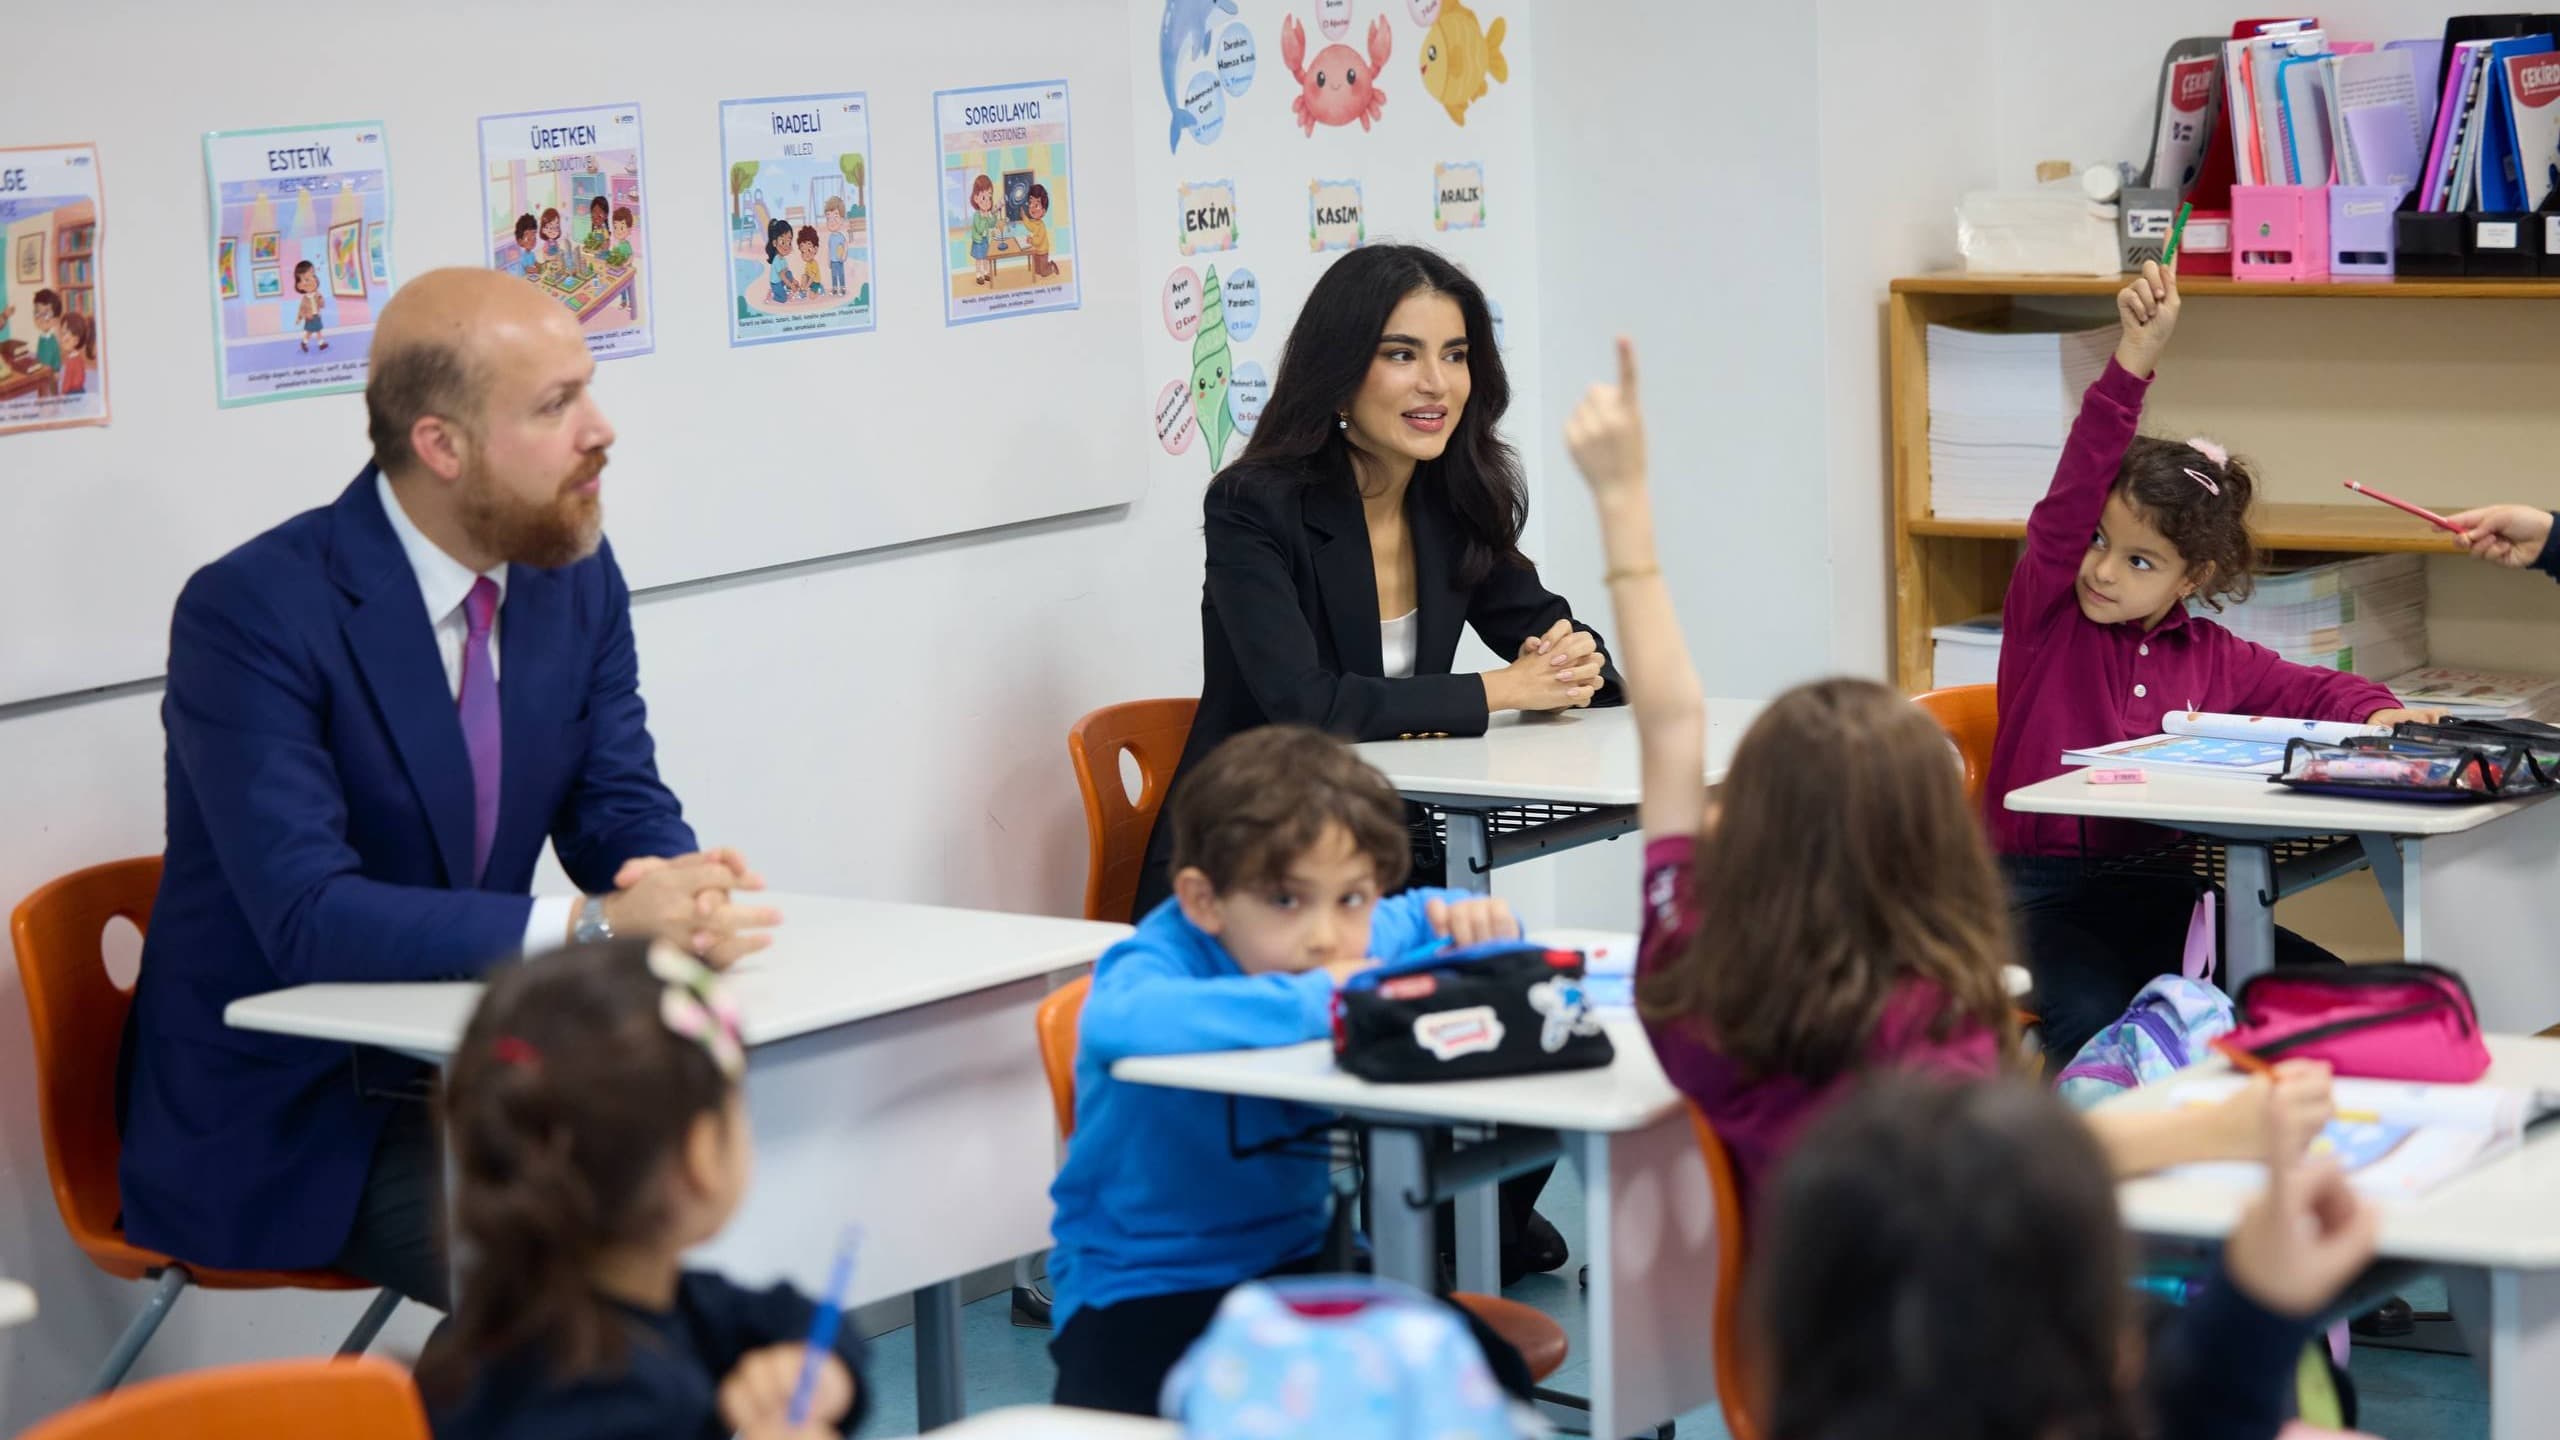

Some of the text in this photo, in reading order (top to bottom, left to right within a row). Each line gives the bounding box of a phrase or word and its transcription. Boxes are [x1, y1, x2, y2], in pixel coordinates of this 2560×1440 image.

[771, 108, 822, 136] İRADELİ
[965, 100, 1041, 126] SORGULAYICI
[531, 124, 597, 150] ÜRETKEN
[982, 126, 1027, 144] QUESTIONER
[267, 141, 333, 171] ESTETİK
[783, 142, 814, 157] WILLED
[1440, 187, 1480, 205] ARALIK
[1186, 202, 1231, 232] EKİM
[1316, 205, 1359, 226] KASIM
